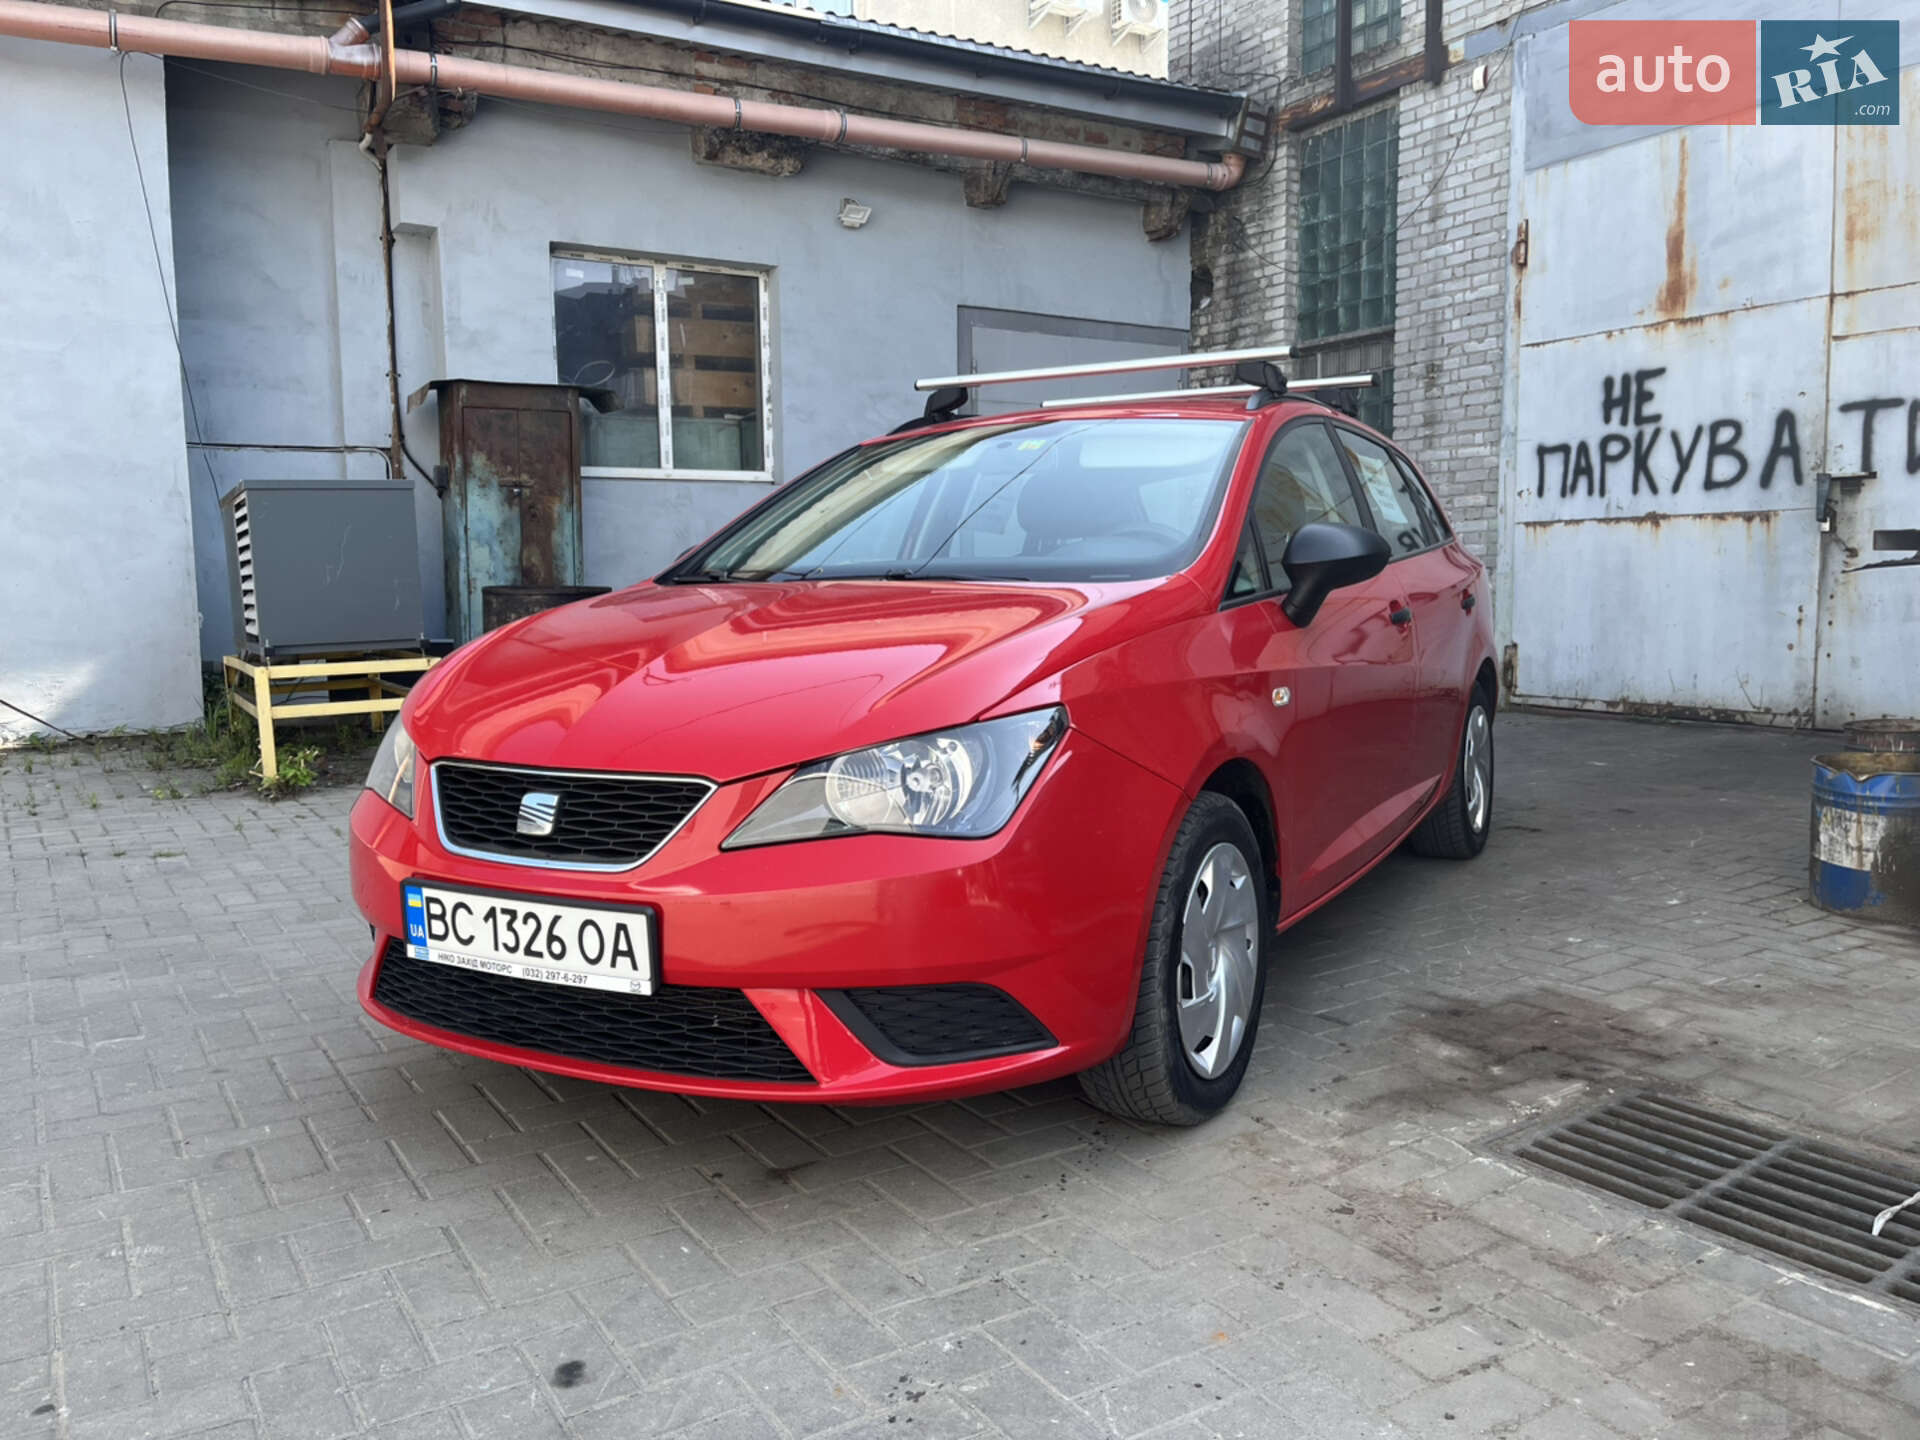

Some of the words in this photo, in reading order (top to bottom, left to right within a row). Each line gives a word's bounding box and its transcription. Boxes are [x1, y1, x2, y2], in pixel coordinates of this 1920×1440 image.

[1602, 367, 1667, 426] НЕ
[410, 923, 425, 938] UA
[483, 906, 567, 961] 1326
[578, 919, 639, 971] OA
